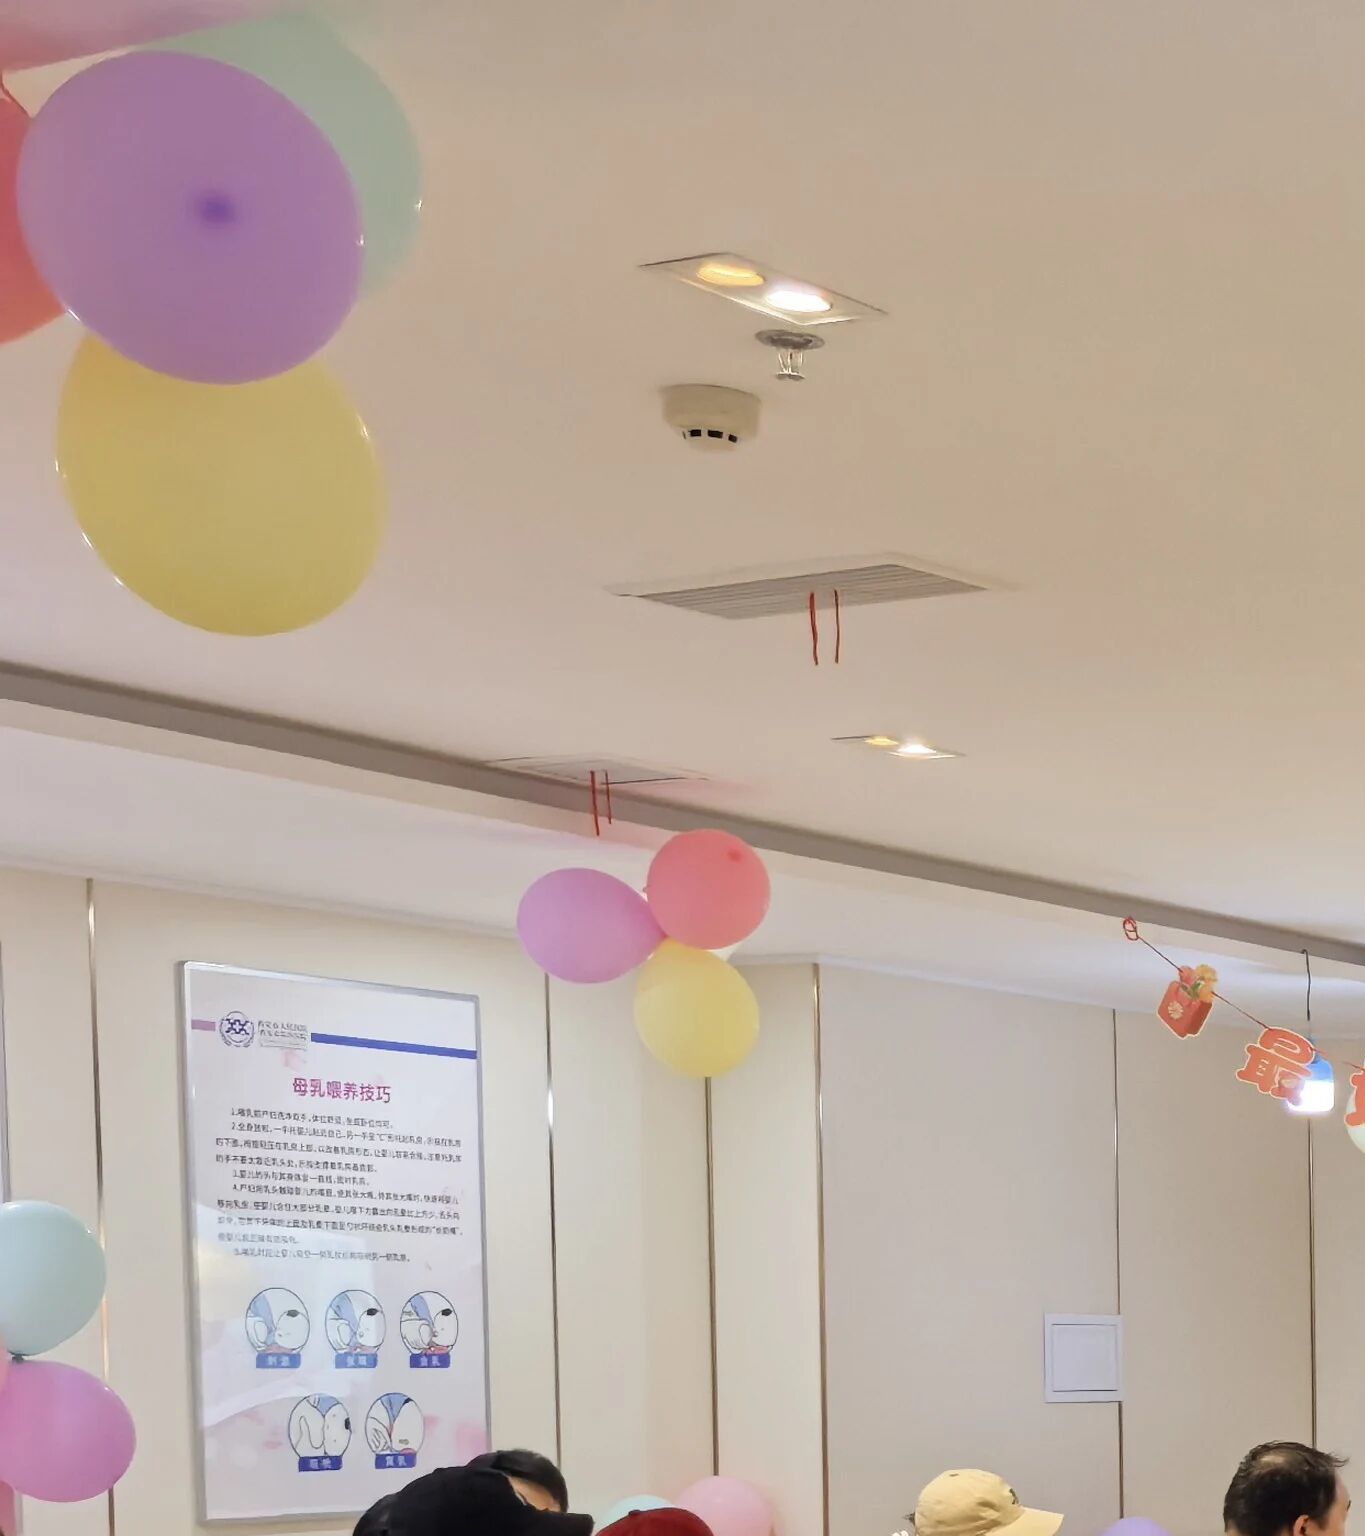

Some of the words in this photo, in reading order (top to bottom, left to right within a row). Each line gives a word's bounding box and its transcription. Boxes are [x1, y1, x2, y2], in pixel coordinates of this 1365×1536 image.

[292, 1077, 392, 1104] 母乳喂养技巧
